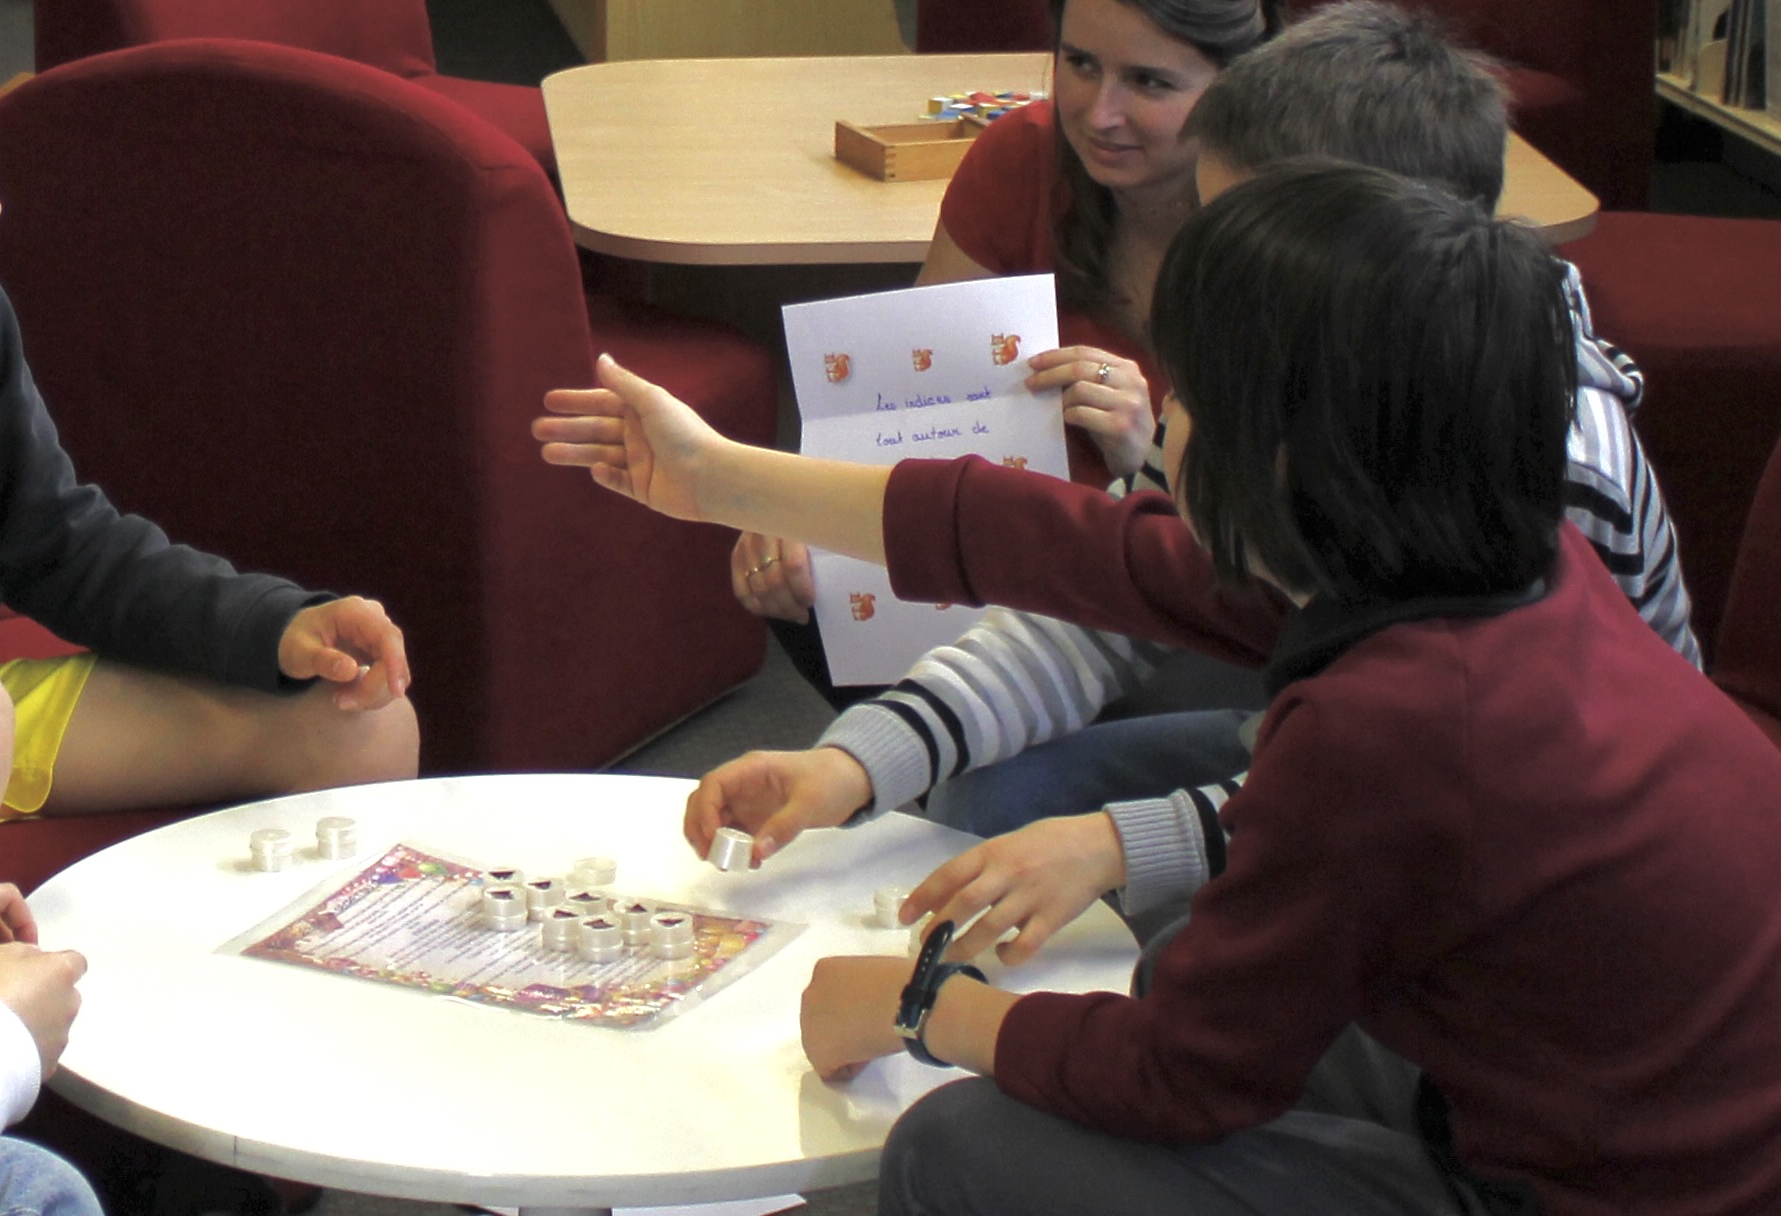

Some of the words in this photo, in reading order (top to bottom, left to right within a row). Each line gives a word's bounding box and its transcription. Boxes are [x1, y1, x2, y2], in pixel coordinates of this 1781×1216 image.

[876, 392, 897, 411] Les
[905, 393, 951, 408] indices
[876, 431, 903, 447] tout
[911, 426, 963, 442] autour
[972, 420, 989, 435] de
